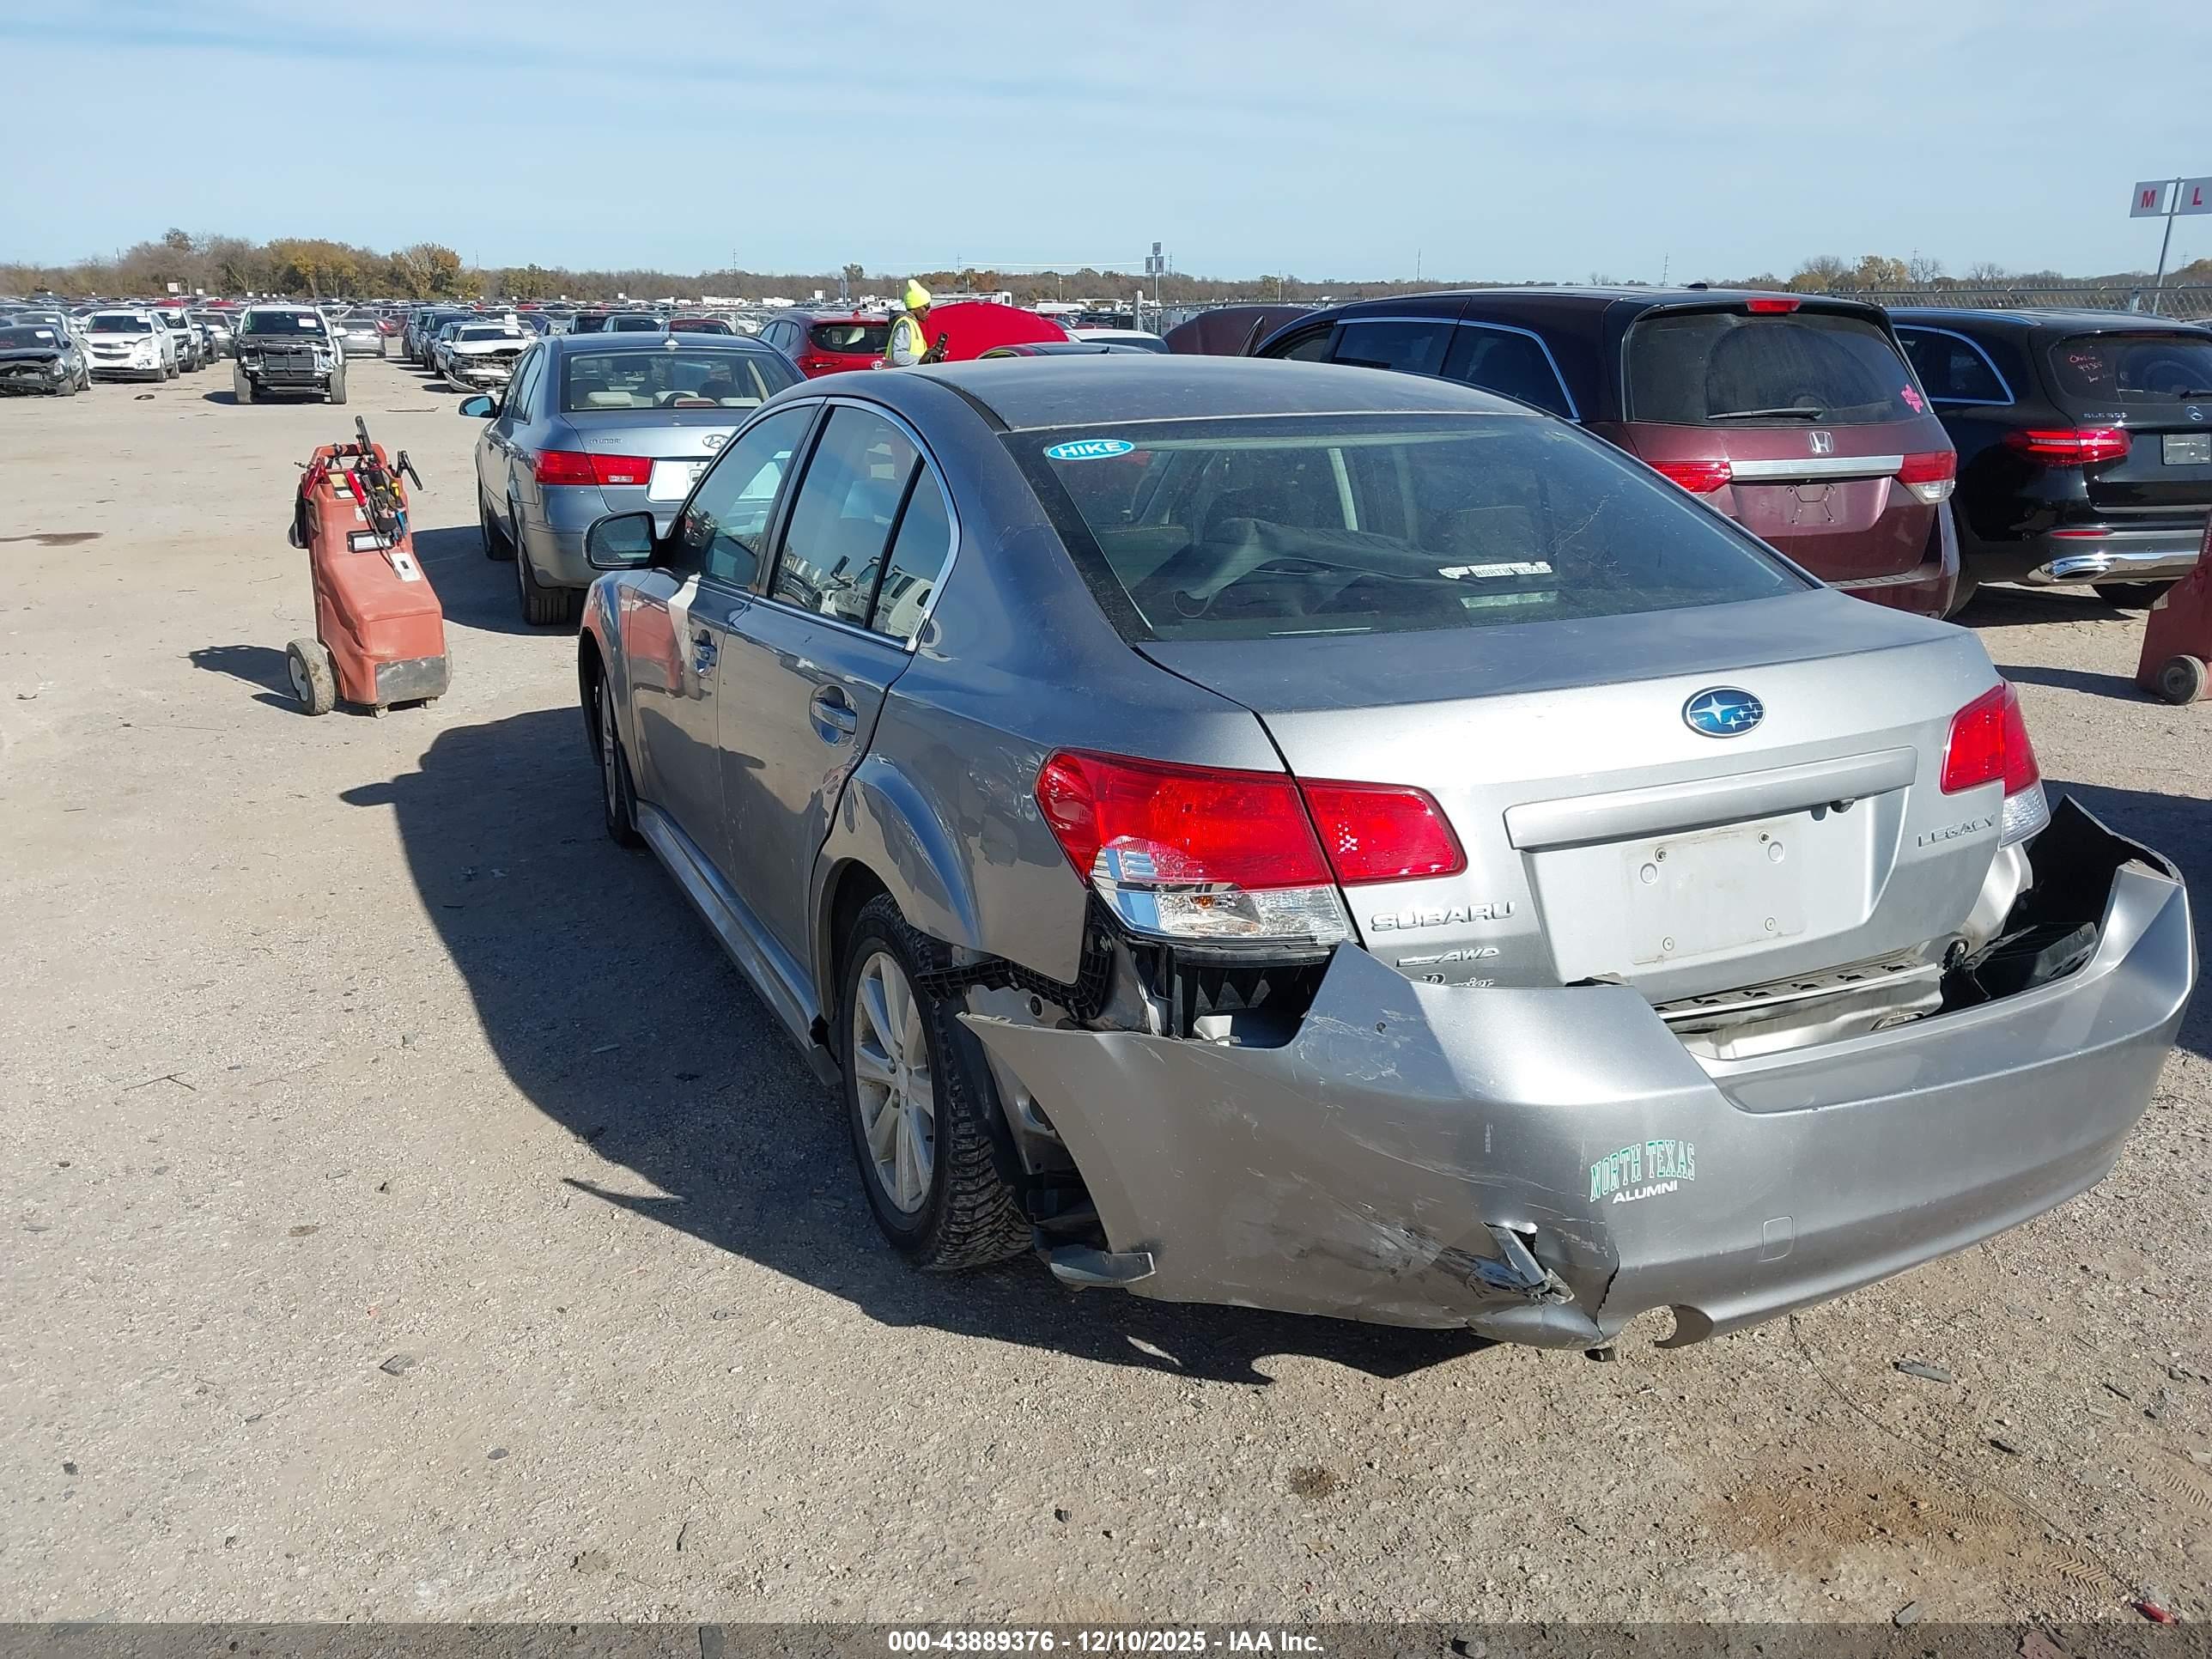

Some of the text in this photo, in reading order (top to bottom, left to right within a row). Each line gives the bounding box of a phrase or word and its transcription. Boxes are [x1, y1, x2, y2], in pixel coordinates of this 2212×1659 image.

[2141, 190, 2157, 208] M
[2191, 187, 2203, 205] L
[1057, 441, 1124, 457] HIKE
[1474, 567, 1513, 577] NORTH
[1514, 565, 1553, 574] TEXAS
[1917, 815, 1994, 848] LEGACY
[1371, 902, 1516, 932] SUBARU
[1436, 948, 1499, 963] AWD
[1589, 1139, 1696, 1202] NORTH TEXAS
[1612, 1180, 1678, 1204] ALUMNI
